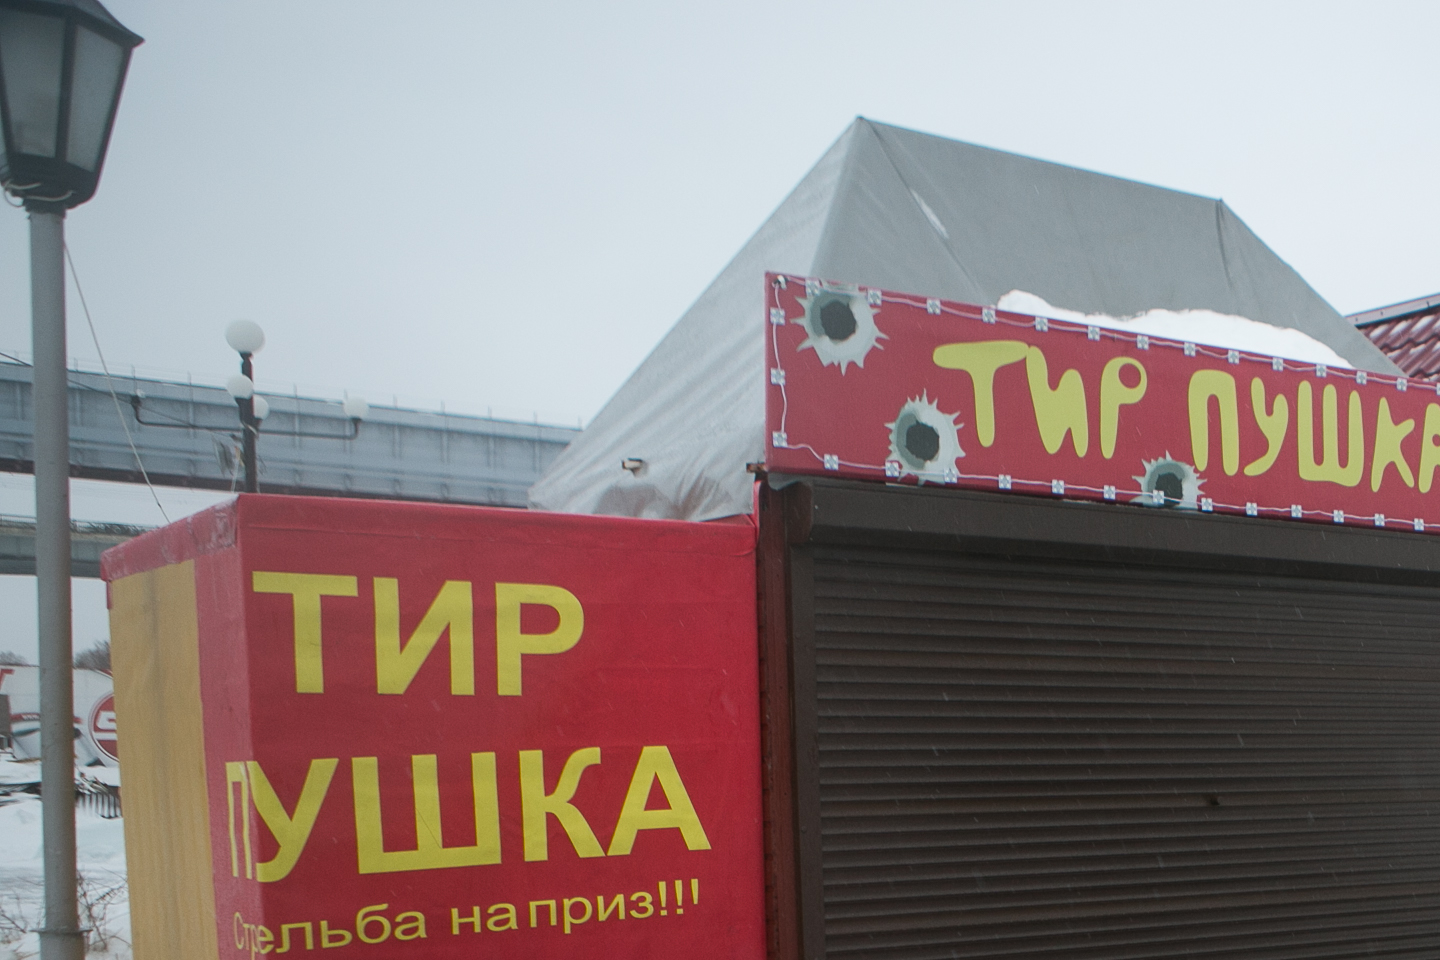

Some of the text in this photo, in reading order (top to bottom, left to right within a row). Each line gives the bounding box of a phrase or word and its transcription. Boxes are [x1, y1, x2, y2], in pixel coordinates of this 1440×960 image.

[932, 340, 1147, 459] ТИР
[252, 571, 584, 696] ТИР
[225, 745, 711, 883] ПУШКА
[450, 903, 518, 935] на
[528, 878, 699, 934] приз!!!
